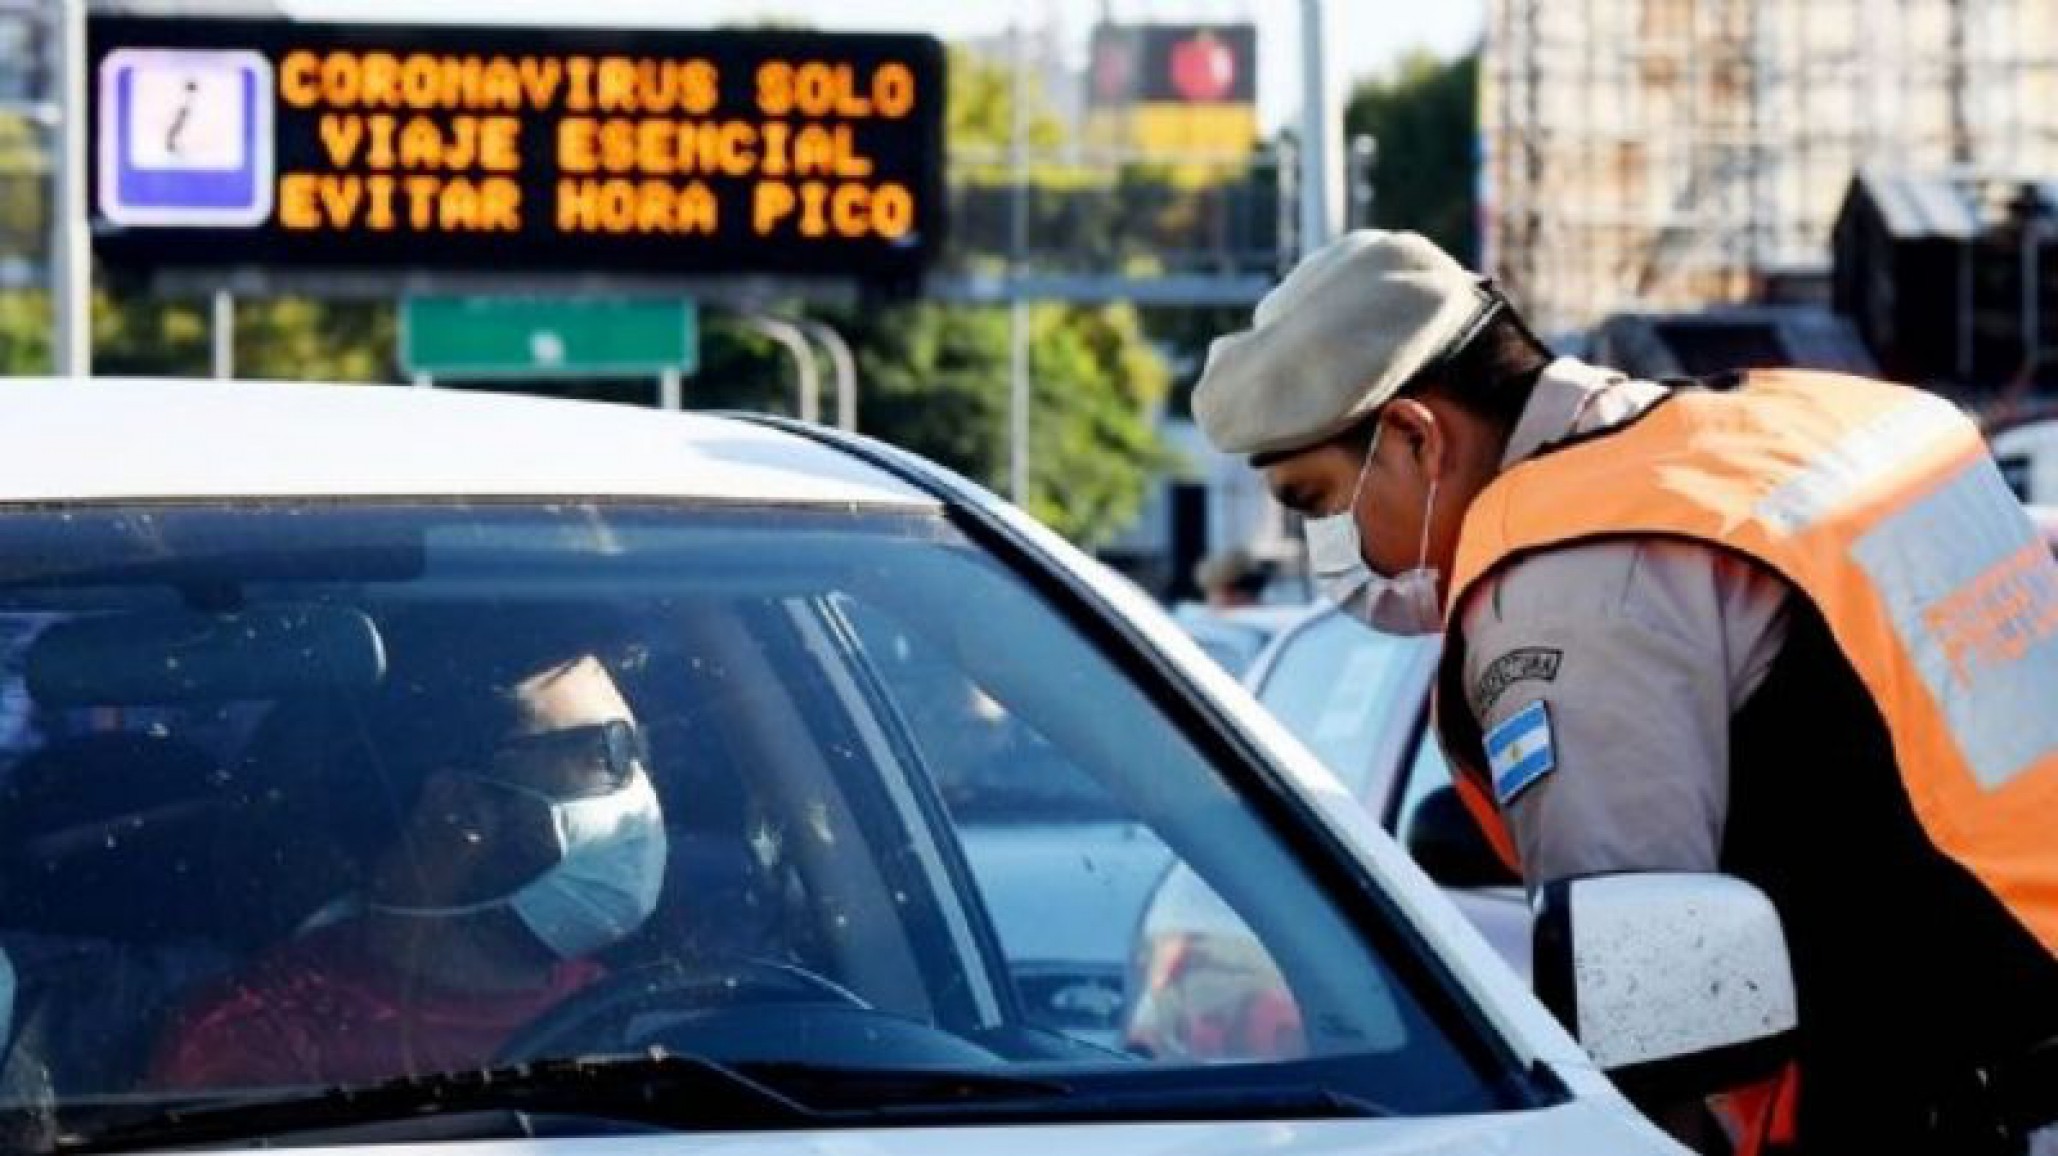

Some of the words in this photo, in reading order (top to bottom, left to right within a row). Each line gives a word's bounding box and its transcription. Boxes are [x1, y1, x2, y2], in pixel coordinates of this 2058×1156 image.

[279, 50, 718, 112] CORONAVIRUS
[757, 62, 914, 117] SOLO
[319, 114, 519, 169] VIAJE
[557, 117, 872, 176] ESENCIAL
[279, 174, 519, 231] EVITAR
[556, 178, 718, 234] HORA
[753, 180, 913, 238] PICO
